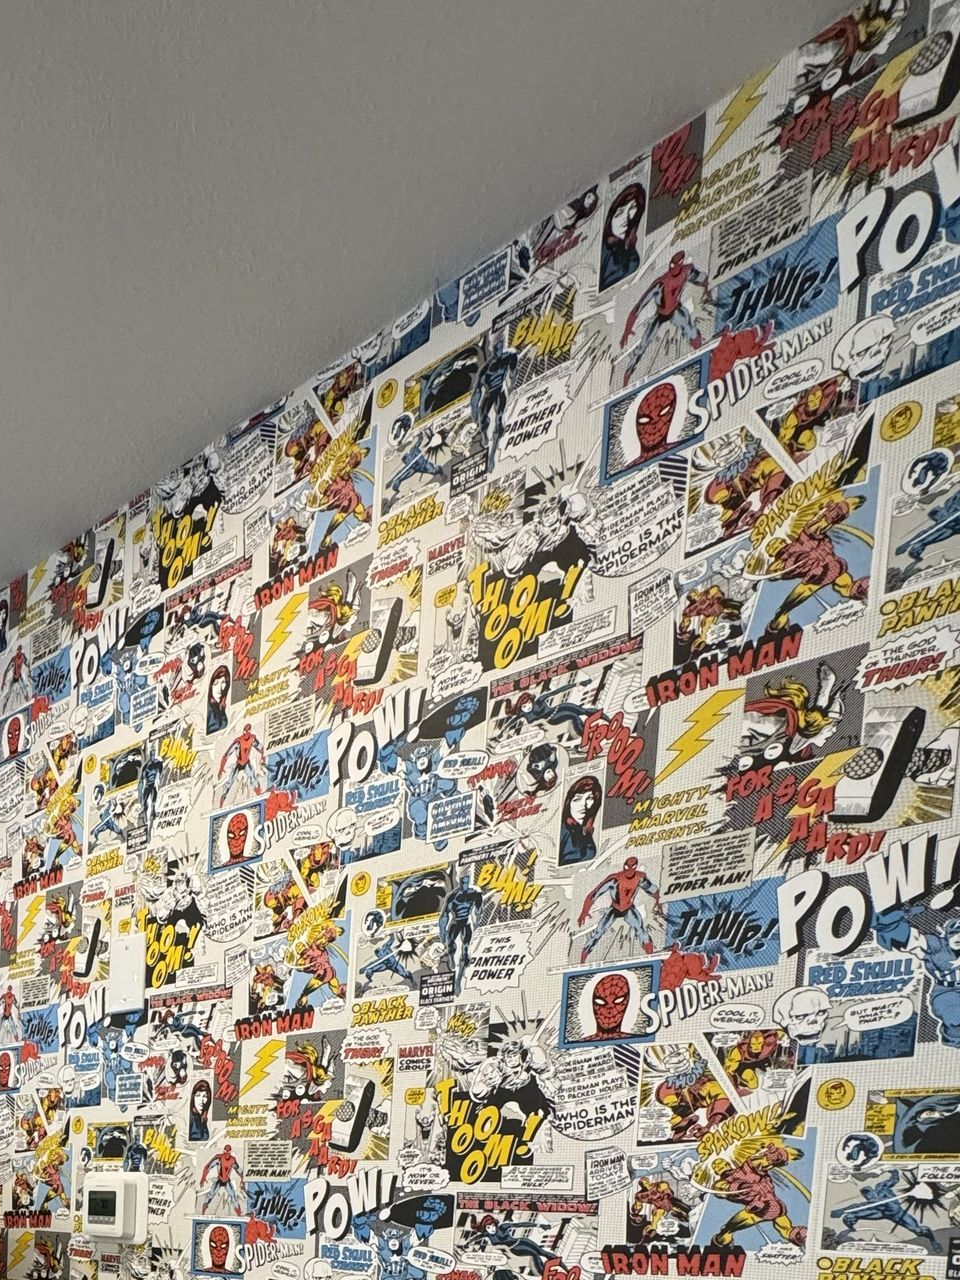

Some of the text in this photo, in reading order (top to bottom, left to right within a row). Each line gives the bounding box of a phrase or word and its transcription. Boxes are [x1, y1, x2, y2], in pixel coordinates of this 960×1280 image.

[677, 140, 764, 208] MIGHTY
[674, 160, 762, 227] MARVEL
[712, 215, 808, 282] SPIDER-MAN!
[727, 254, 838, 322] THWIP!
[686, 315, 831, 439] SPIDER-MAN!
[503, 418, 552, 453] POWER
[254, 544, 339, 611] IRON MAN
[68, 605, 127, 689] POW!
[881, 635, 936, 659] THE GOD
[882, 642, 939, 666] THUNDER,
[646, 626, 804, 708] IRON MAN
[860, 650, 946, 690] THOR!
[327, 686, 423, 785] POW!
[273, 758, 328, 789] THWIP!
[724, 763, 772, 803] FOR
[631, 783, 711, 815] MIGHTY
[253, 799, 325, 857] SPIDER-MAN!
[628, 802, 709, 832] MARVEL
[663, 869, 752, 896] SPIDER-MAN!
[677, 909, 779, 954] THWIP!
[469, 967, 515, 982] POWER
[807, 954, 916, 985] RED SKULL
[351, 1005, 414, 1027] PANTHER
[360, 994, 408, 1013] BLACK
[639, 971, 772, 1034] SPIDER-MAN!
[715, 1009, 746, 1019] COOL
[25, 1017, 58, 1045] THWIP!
[234, 1008, 315, 1042] IRON MAN
[556, 1108, 589, 1122] WHO
[610, 1095, 637, 1111] THE
[556, 1107, 634, 1132] SPIDERMAN
[253, 1190, 305, 1227] THWIP!
[303, 1166, 394, 1239] POW!
[458, 1198, 597, 1213] THE BLACK WIDOW!
[234, 1243, 303, 1274] SPIDER-MAN!
[601, 1246, 747, 1278] IRON MAN
[832, 1256, 925, 1274] BLACK
